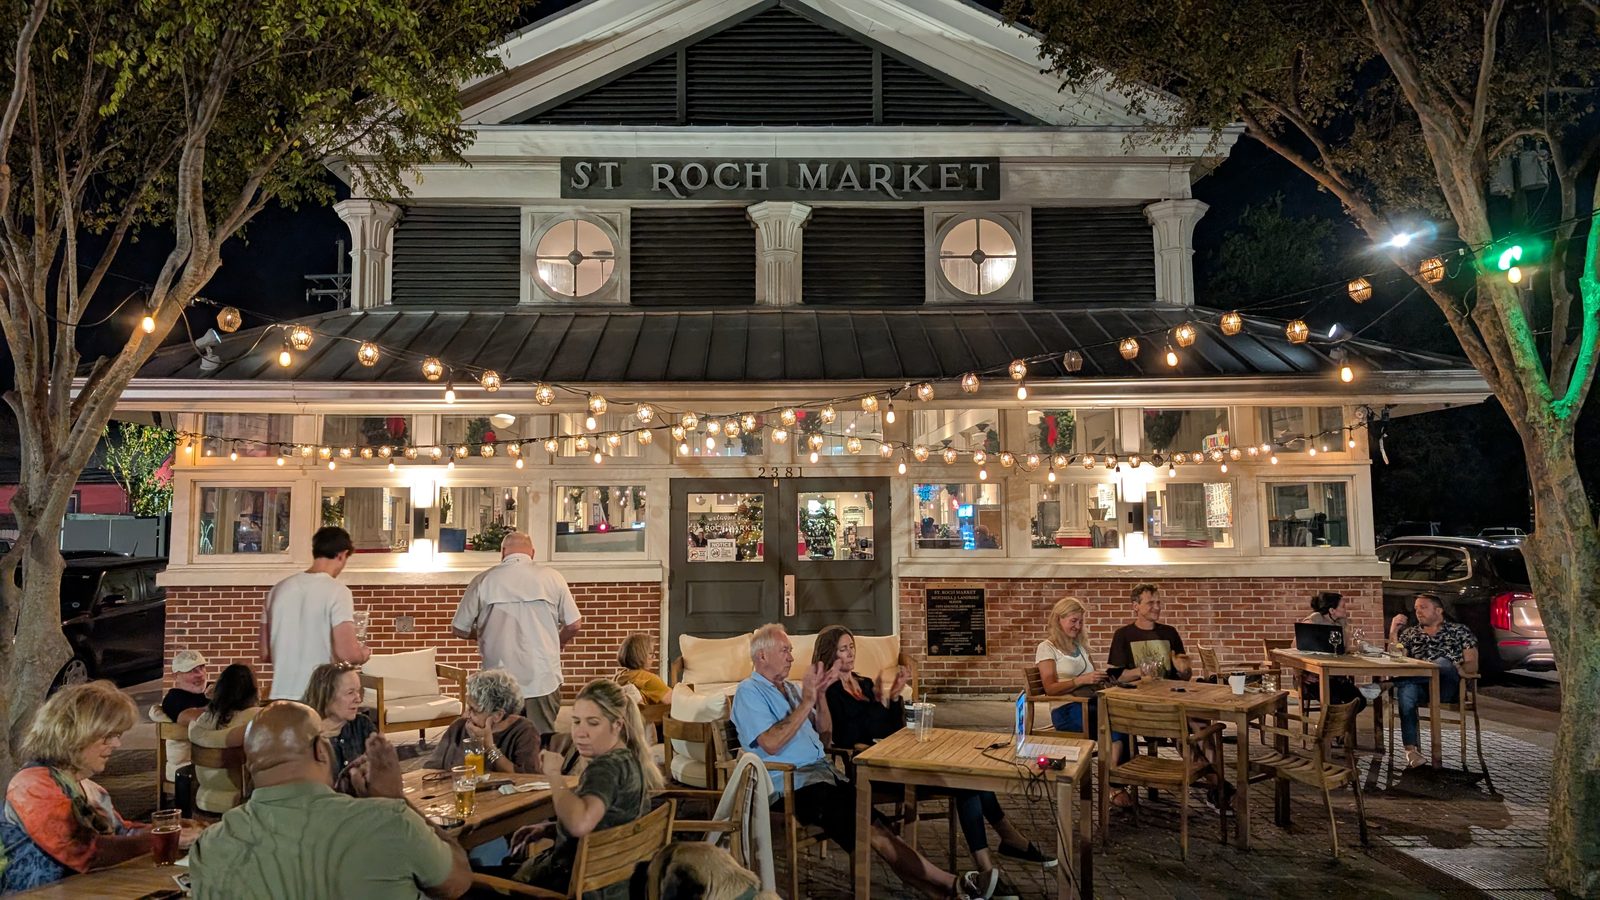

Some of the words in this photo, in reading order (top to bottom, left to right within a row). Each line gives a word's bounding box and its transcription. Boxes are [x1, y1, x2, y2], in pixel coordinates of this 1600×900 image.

[571, 161, 618, 190] ST
[651, 162, 769, 198] ROCH
[798, 163, 990, 199] MARKET
[758, 466, 804, 478] 2381
